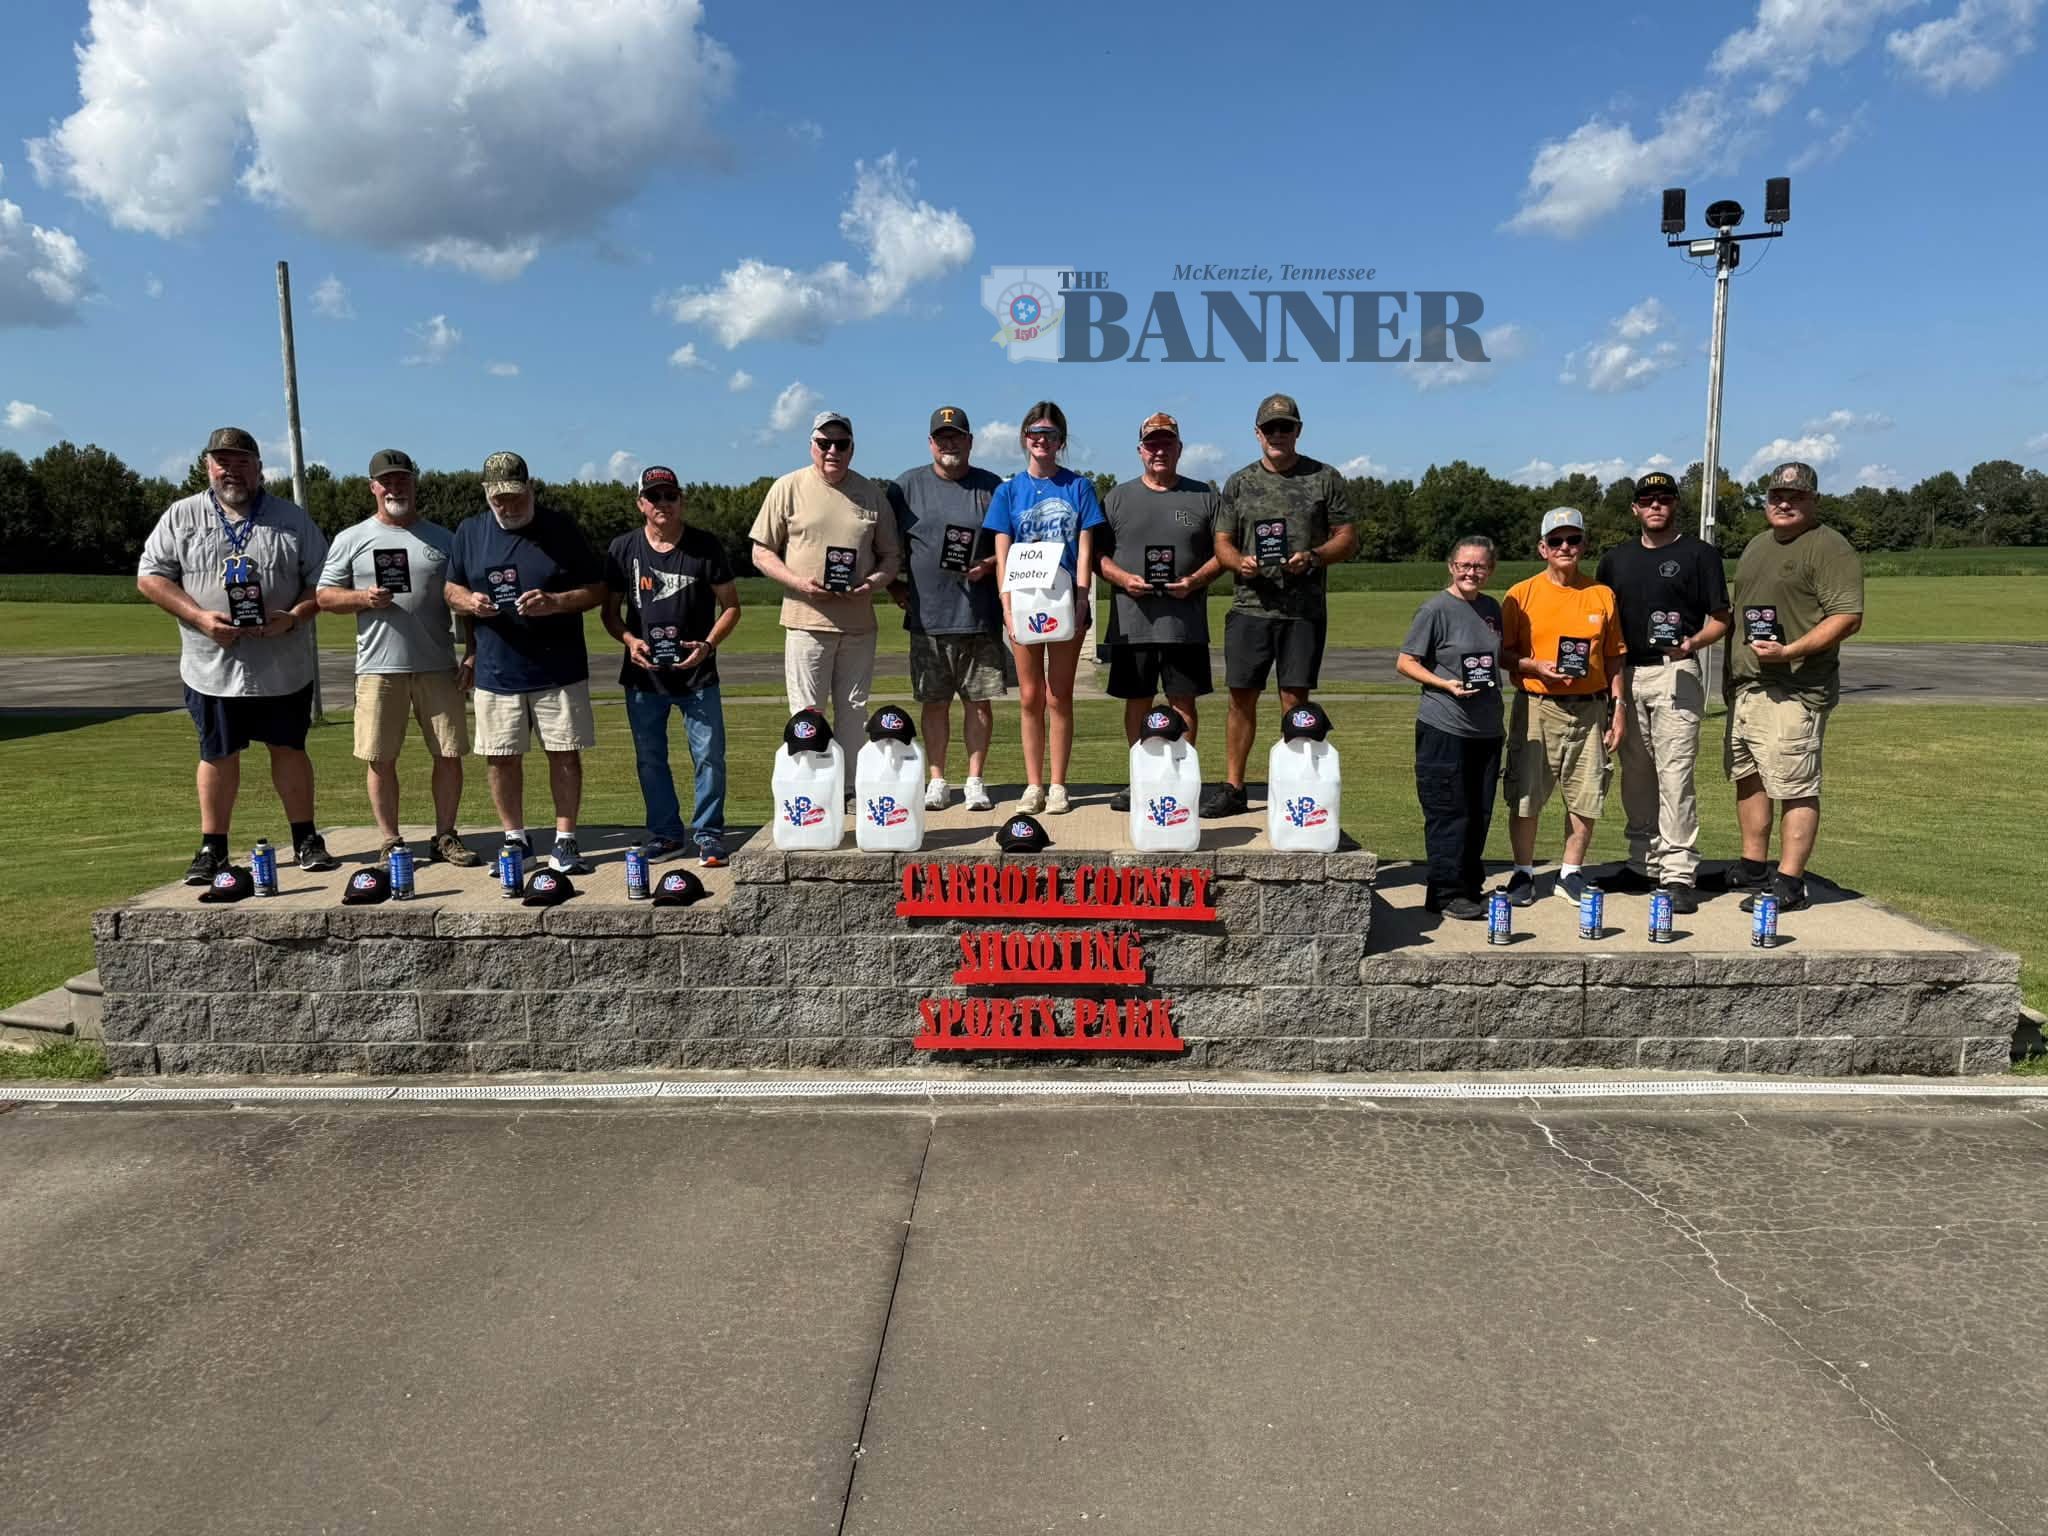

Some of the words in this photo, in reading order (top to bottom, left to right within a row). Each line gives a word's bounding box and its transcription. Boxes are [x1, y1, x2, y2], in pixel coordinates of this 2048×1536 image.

[940, 409, 955, 423] T
[1020, 516, 1071, 536] QUICK
[1019, 550, 1043, 560] HOA
[1009, 570, 1049, 582] Shooter
[1029, 612, 1048, 634] VP
[784, 796, 812, 827] VP
[868, 796, 896, 827] VP
[1149, 796, 1176, 827] VP
[1286, 796, 1315, 827] VP
[901, 863, 1065, 905] CARROLL
[1075, 866, 1212, 907] COUNTY
[959, 930, 1142, 972] SHOOTING
[918, 998, 1056, 1038] SPORTS
[1075, 998, 1175, 1039] PARK
